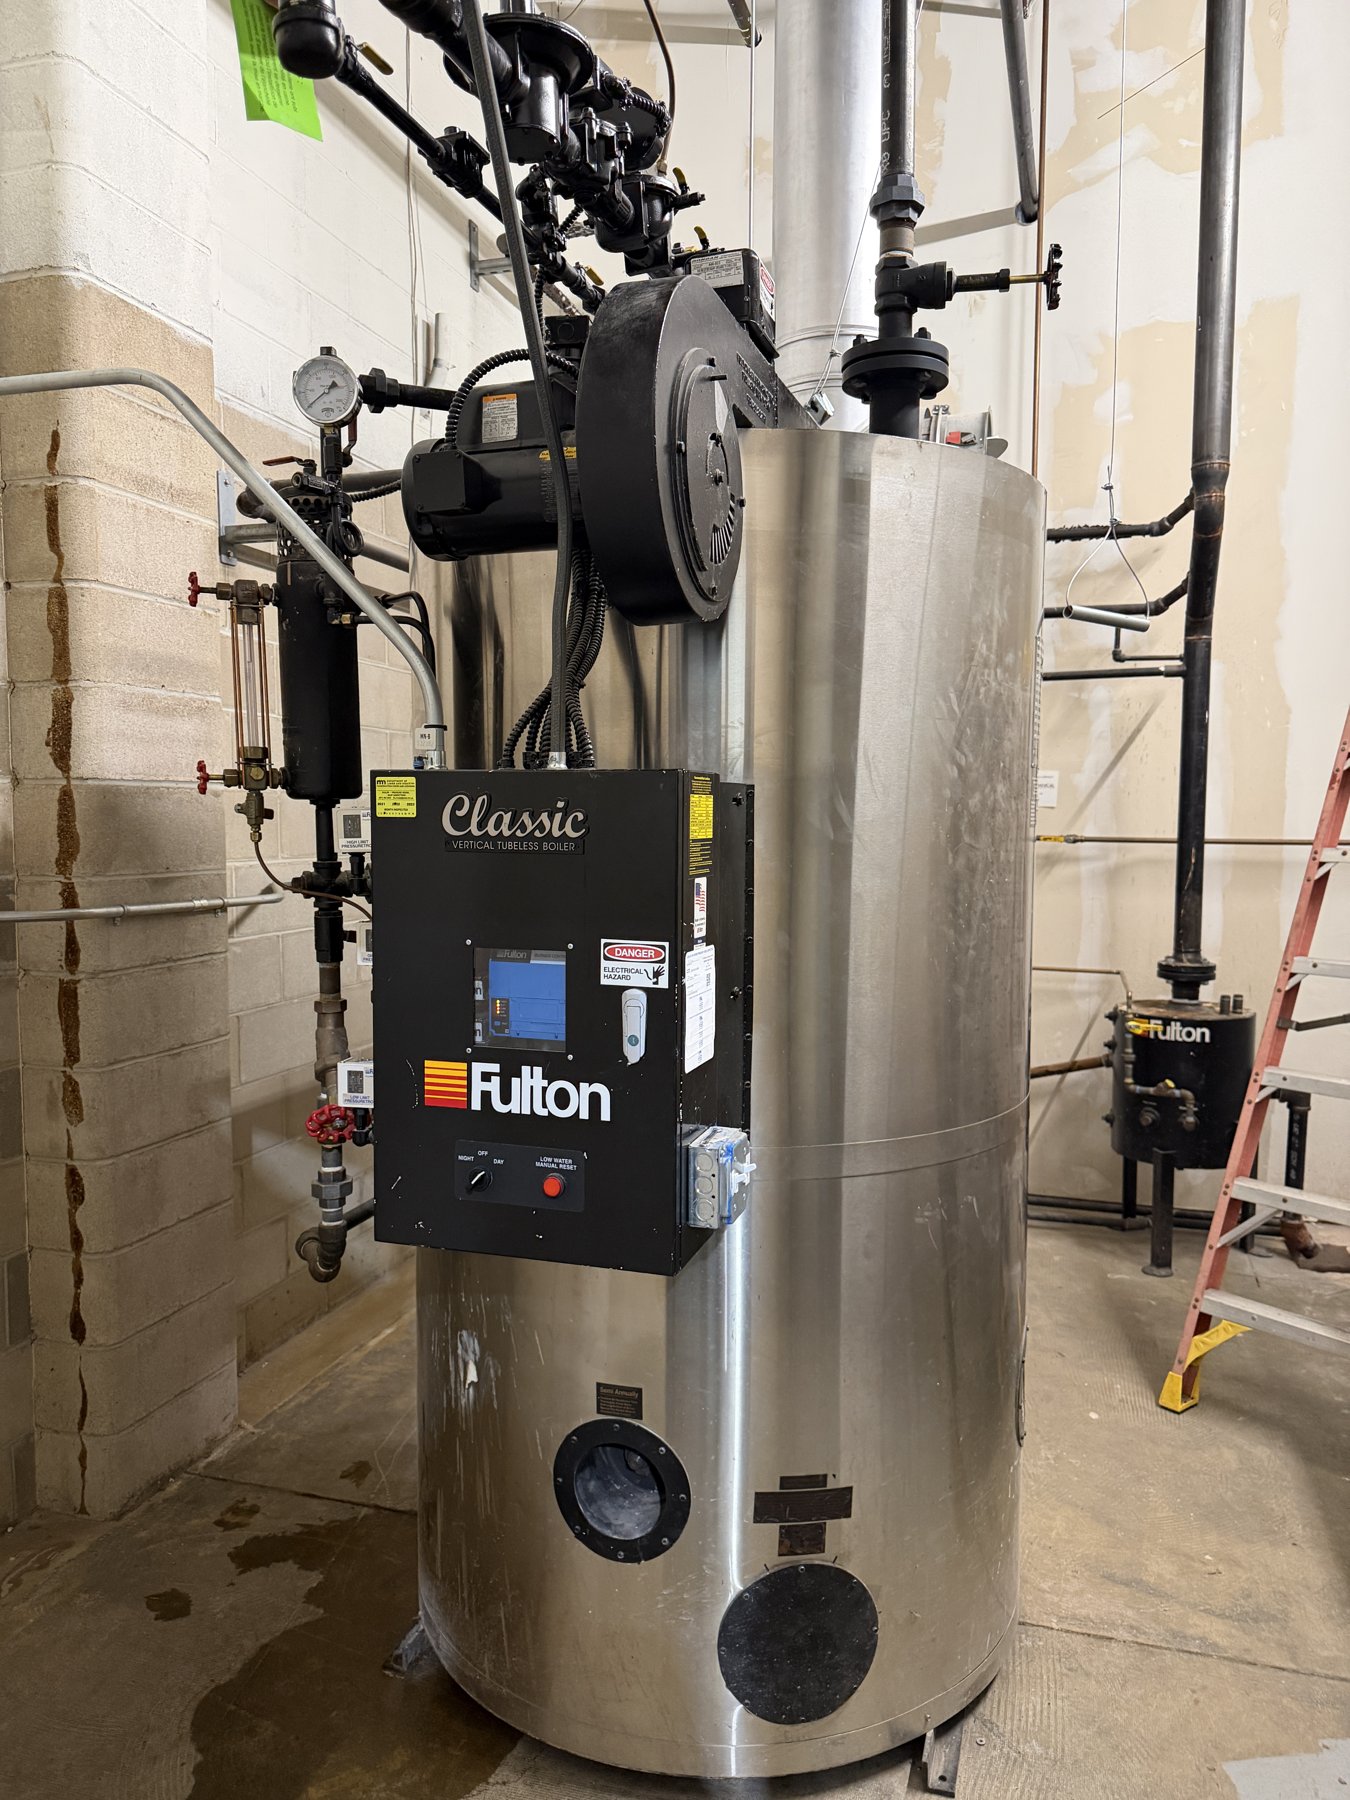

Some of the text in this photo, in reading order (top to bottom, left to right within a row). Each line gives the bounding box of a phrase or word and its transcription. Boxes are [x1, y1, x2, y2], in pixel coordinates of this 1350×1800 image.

[441, 794, 586, 838] Classic
[452, 840, 575, 851] VERTICAL TUBELESS BOILER
[503, 949, 527, 959] Fulton
[614, 947, 655, 959] DANGER
[603, 966, 643, 975] ELECTRICAL
[603, 973, 631, 981] HAZARD
[1149, 1019, 1211, 1043] Fulton
[471, 1061, 611, 1122] Fulton
[535, 1161, 577, 1171] MANUAL RESET
[553, 1157, 573, 1165] WATER
[614, 1388, 639, 1399] Annually
